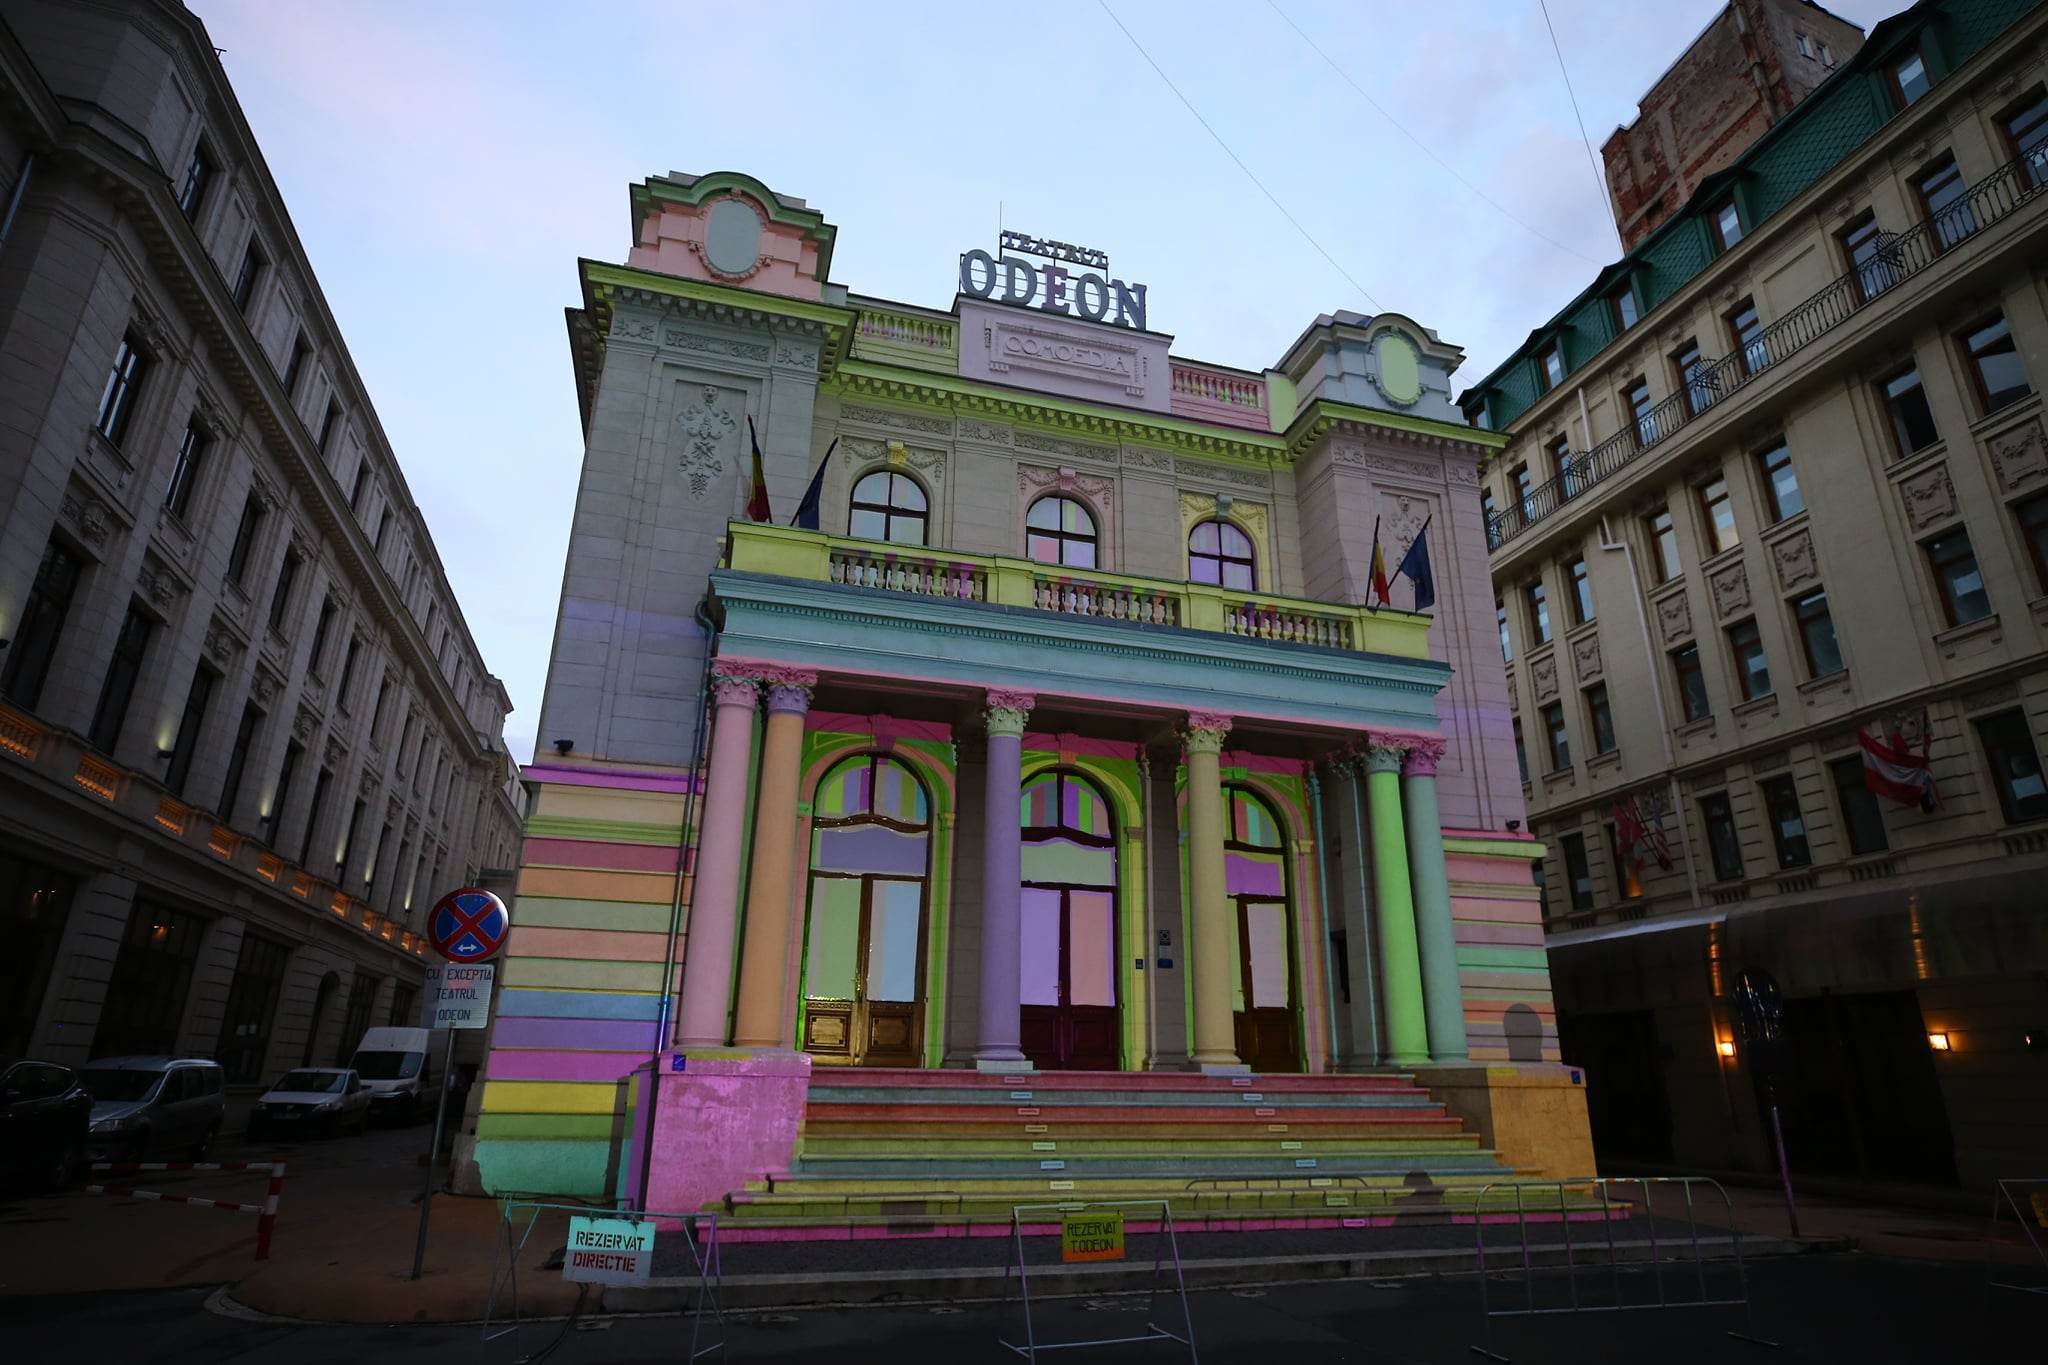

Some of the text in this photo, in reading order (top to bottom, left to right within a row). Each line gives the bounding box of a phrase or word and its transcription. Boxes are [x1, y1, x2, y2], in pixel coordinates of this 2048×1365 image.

[1002, 229, 1109, 268] TEATRUL
[959, 248, 1147, 331] ODEON
[425, 967, 441, 981] CU
[436, 987, 478, 1000] TEATRUL
[438, 1009, 471, 1021] ODEON
[1067, 1221, 1117, 1237] REZERVAT
[575, 1231, 645, 1252] REZERVAT
[573, 1252, 636, 1273] DIRECTIE
